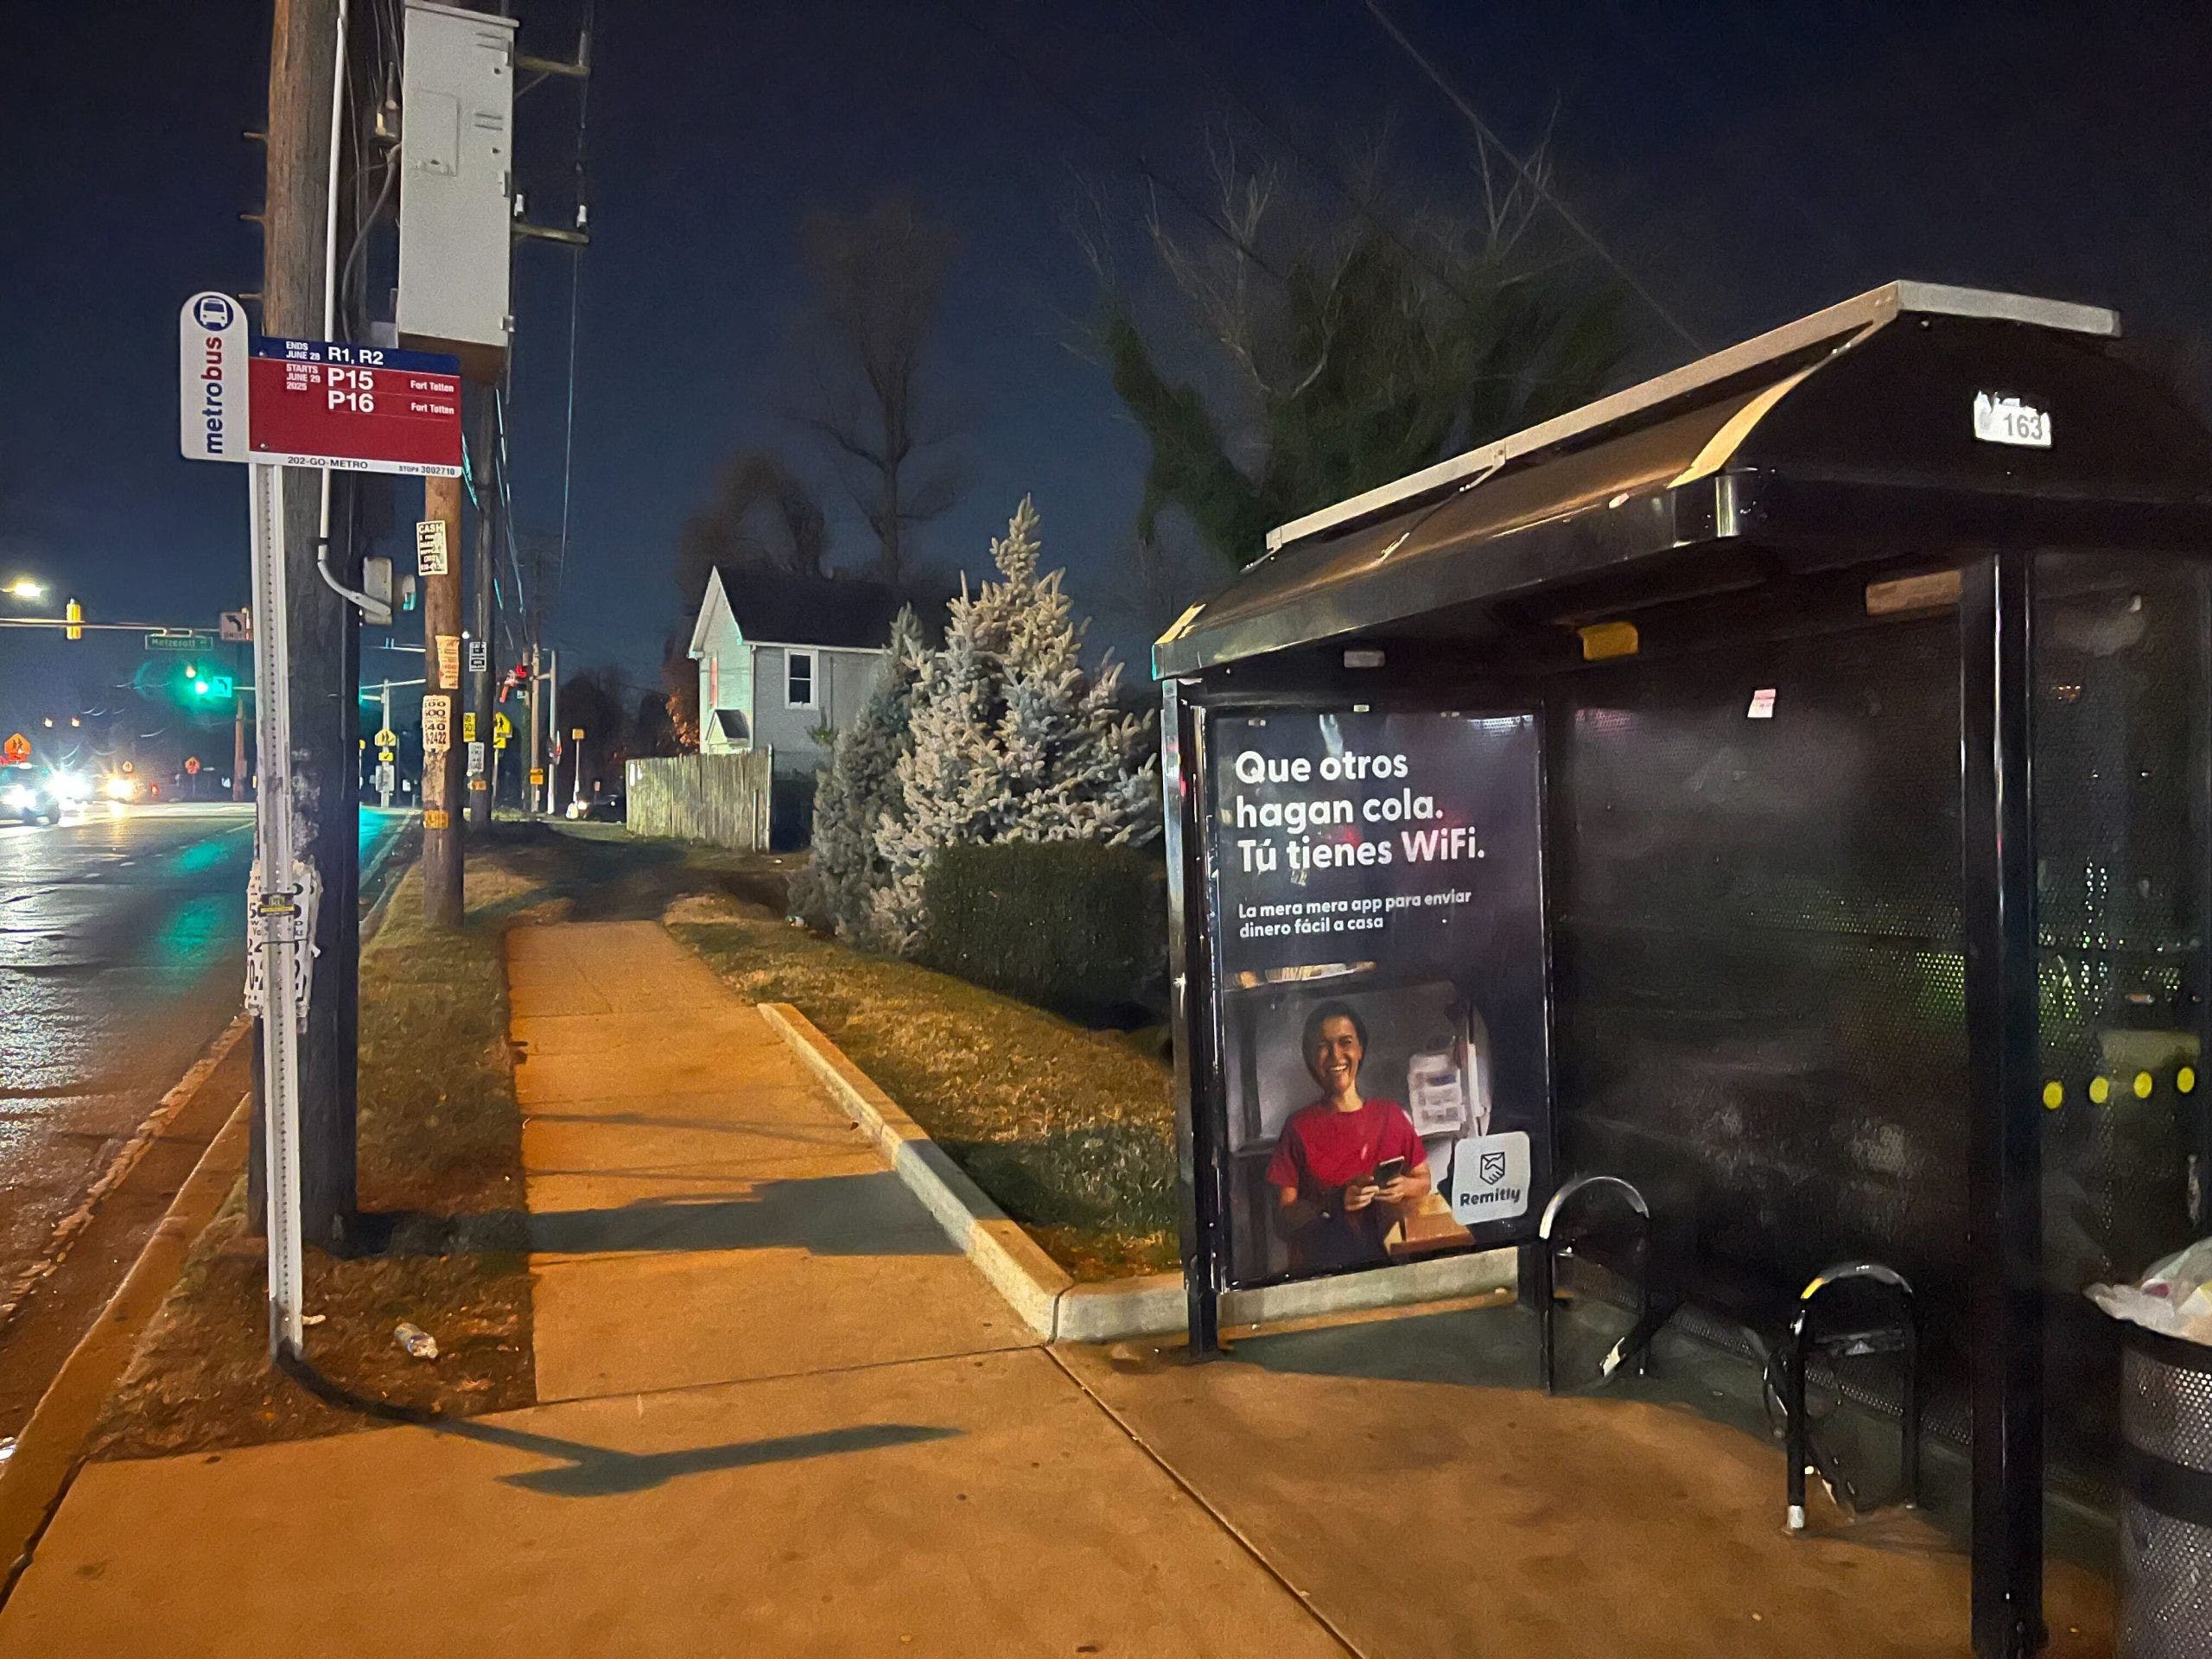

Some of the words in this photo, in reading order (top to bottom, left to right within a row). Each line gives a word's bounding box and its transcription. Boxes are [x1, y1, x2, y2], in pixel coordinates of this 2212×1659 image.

[285, 341, 308, 351] ENDS
[286, 350, 308, 359] JUNE
[309, 352, 321, 360] 28
[328, 346, 355, 364] R1,
[359, 349, 384, 365] R2
[286, 364, 318, 373] STARTS
[286, 372, 308, 382] JUNE
[310, 374, 321, 383] 29
[327, 367, 374, 391] P15
[410, 379, 428, 390] Fort
[429, 381, 454, 393] Totten
[200, 336, 224, 454] metrobus
[327, 390, 374, 413] P16
[410, 402, 428, 413] Fort
[429, 404, 454, 415] Totten
[2004, 413, 2043, 440] 163
[418, 524, 443, 534] CASH
[1236, 751, 1311, 784] Que
[1319, 751, 1408, 779] otros
[1236, 795, 1353, 834] hagan
[1363, 787, 1444, 823] cola.
[1237, 836, 1276, 872] Tú
[1286, 835, 1393, 869] tienes
[1401, 826, 1484, 862] WiFi.
[1238, 903, 1257, 918] La
[1260, 903, 1302, 917] mera
[1306, 900, 1348, 914] mera
[1351, 898, 1382, 913] app
[1385, 894, 1421, 912] para
[1424, 888, 1471, 906] enviar
[1239, 922, 1292, 938] dinero
[1294, 917, 1331, 934] fácil
[1333, 919, 1344, 931] a
[1347, 917, 1384, 931] casa
[1459, 1187, 1521, 1206] Remitly
